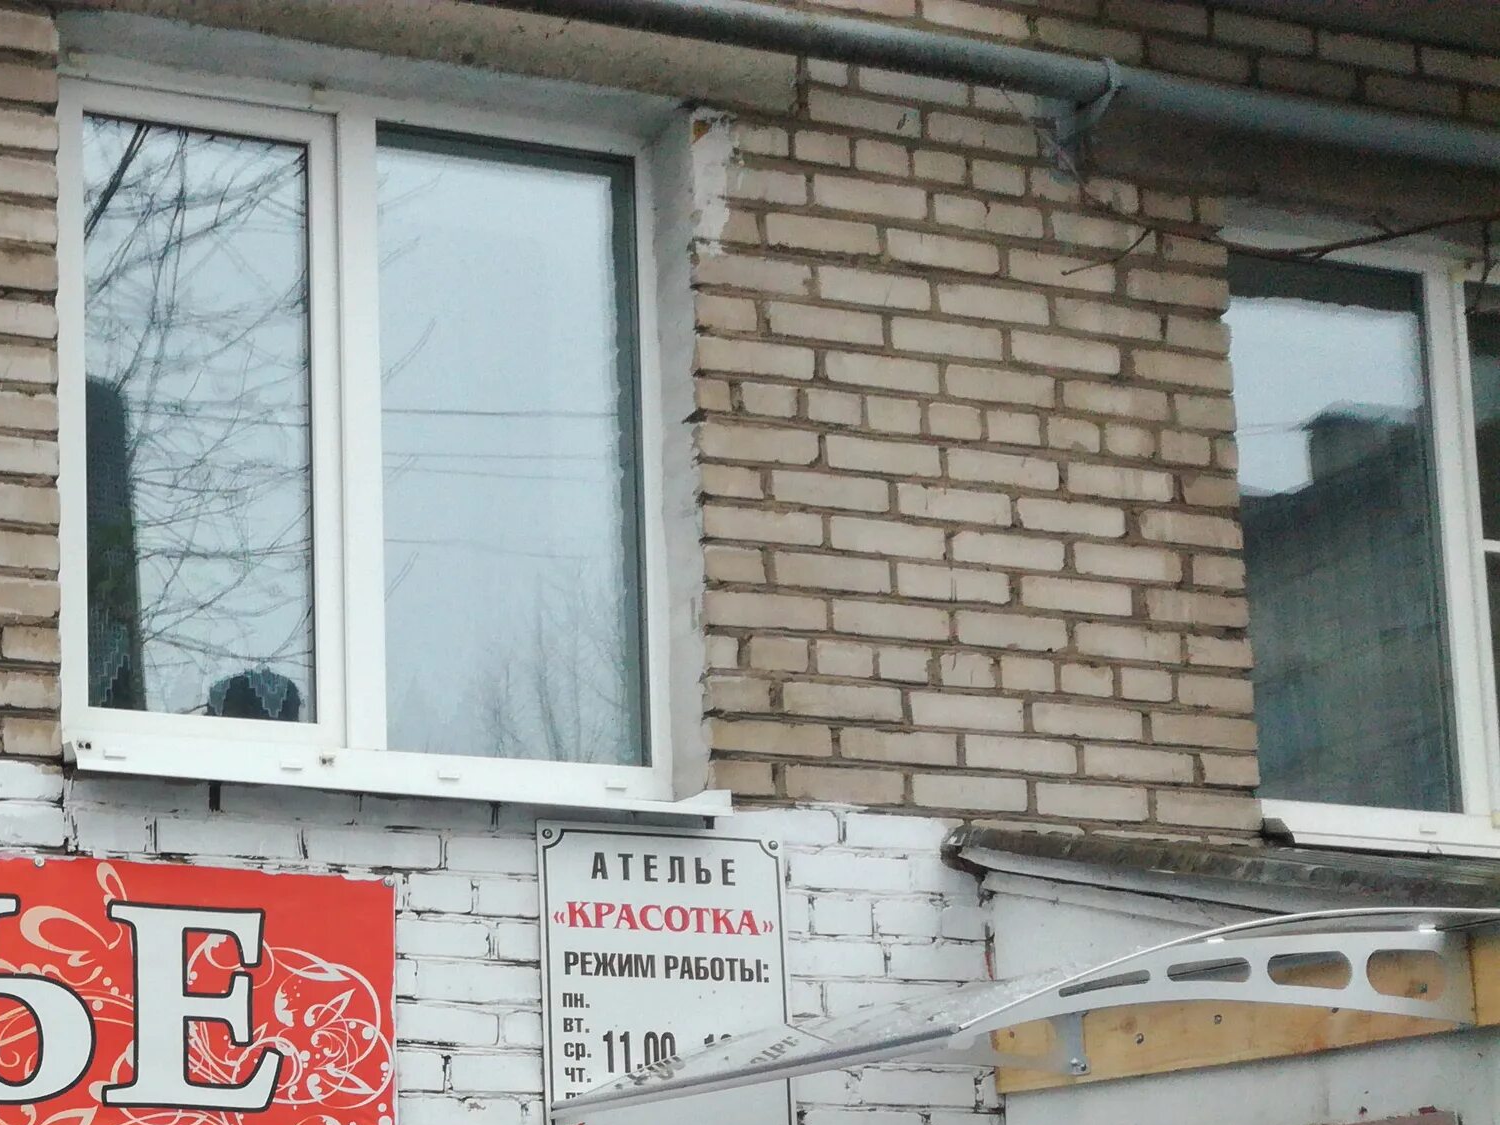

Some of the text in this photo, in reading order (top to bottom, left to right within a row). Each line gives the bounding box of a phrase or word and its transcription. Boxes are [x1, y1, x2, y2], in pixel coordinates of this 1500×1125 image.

[591, 851, 736, 886] АТЕЛЬЕ
[553, 901, 774, 936] «КРАСОТКА»
[563, 951, 770, 983] РЕЖИМ РАБОТЫ:
